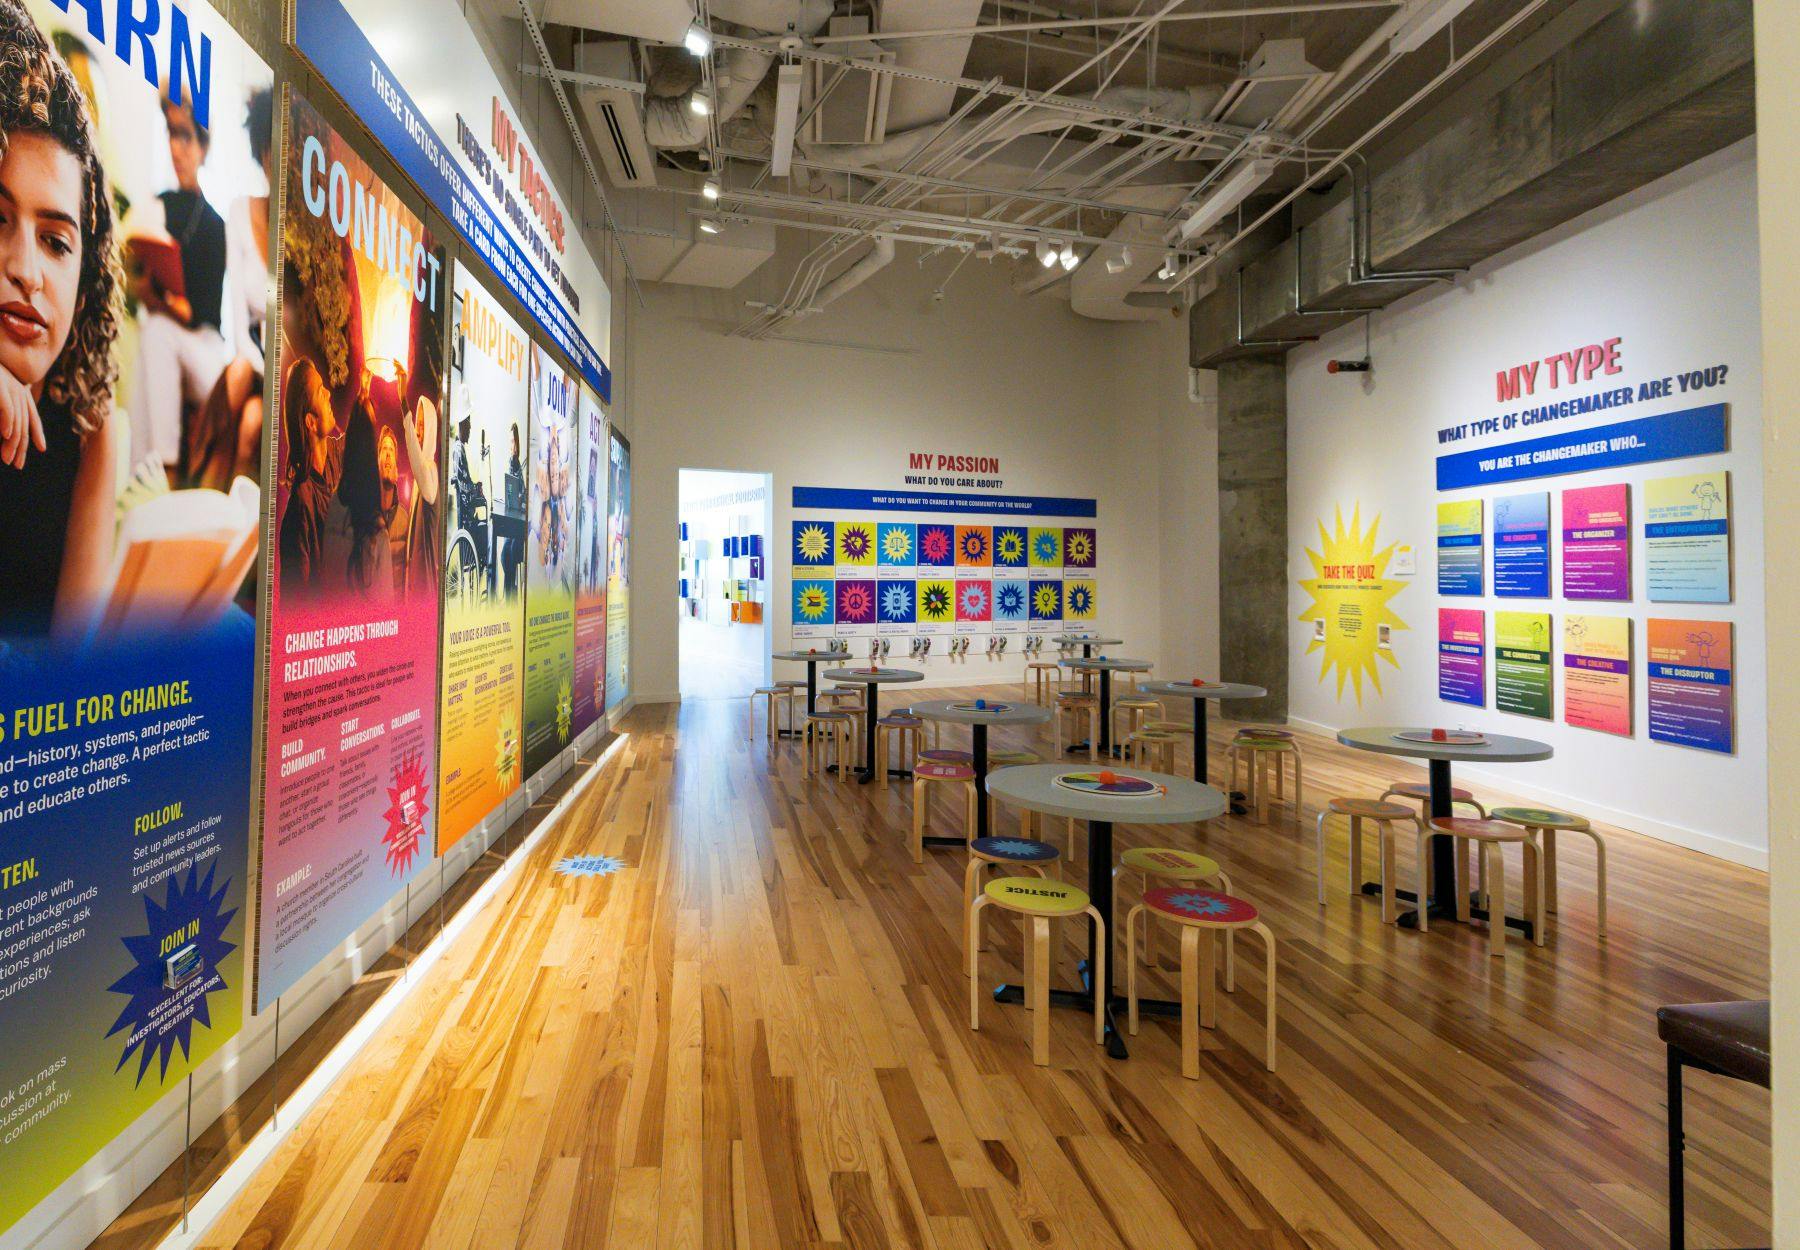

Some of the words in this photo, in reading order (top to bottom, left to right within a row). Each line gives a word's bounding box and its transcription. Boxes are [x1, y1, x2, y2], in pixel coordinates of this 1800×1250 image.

[370, 60, 403, 122] THESE
[404, 105, 439, 168] TACTICS
[440, 154, 461, 195] OFFER
[462, 181, 494, 237] DIFFERENT
[456, 113, 491, 185] THERE'S
[492, 95, 517, 173] MY
[302, 135, 440, 313] CONNECT
[452, 196, 468, 231] TAKE
[468, 216, 474, 239] A
[460, 287, 526, 383] AMPLIFY
[1496, 360, 1539, 403] MY
[1544, 337, 1622, 390] TYPE
[547, 371, 567, 418] JOIN
[1437, 423, 1467, 444] WHAT
[1470, 418, 1500, 440] TYPE
[1503, 412, 1518, 430] OF
[1521, 386, 1634, 427] CHANGEMAKER
[1637, 376, 1672, 402] ARE
[1677, 364, 1728, 393] YOU?
[589, 411, 600, 446] ACT
[909, 453, 934, 471] MY
[937, 454, 999, 474] PASSION
[1479, 457, 1496, 472] YOU
[1497, 455, 1515, 469] ARE
[1515, 453, 1531, 466] THE
[1532, 440, 1608, 464] CHANGEMAKER
[1610, 434, 1646, 451] WHO...
[905, 475, 927, 486] WHAT
[928, 477, 939, 486] DO
[940, 477, 955, 487] YOU
[956, 478, 975, 488] CARE
[976, 479, 1003, 489] ABOUT?
[872, 496, 887, 504] WHAT
[907, 497, 922, 505] WANT
[929, 498, 949, 506] CHANGE
[955, 499, 968, 507] YOUR
[1323, 565, 1340, 580] TAKE
[1342, 565, 1356, 580] THE
[1357, 564, 1375, 582] QUIZ
[285, 629, 324, 654] CHANGE
[327, 626, 365, 648] HAPPENS
[366, 620, 399, 637] THROUGH
[450, 631, 462, 645] YOUR
[284, 650, 357, 682] RELATIONSHIPS.
[1660, 667, 1673, 676] THE
[1674, 668, 1715, 680] DISRUPTOR
[282, 700, 316, 721] strengthen
[317, 697, 326, 708] the
[283, 688, 301, 702] When
[303, 687, 313, 699] you
[314, 680, 336, 693] connect
[14, 702, 69, 740] FUEL
[76, 694, 114, 727] FOR
[120, 680, 193, 717] CHANGE.
[282, 719, 298, 734] build
[299, 712, 320, 730] bridges
[322, 708, 331, 720] and
[333, 703, 347, 718] spark
[341, 718, 359, 735] START
[85, 730, 138, 755] systems,
[141, 720, 160, 739] and
[163, 713, 204, 736] people—
[282, 739, 303, 759] BUILD
[340, 723, 385, 752] CONVERSATIONS.
[13, 779, 29, 795] to
[33, 765, 79, 789] create
[82, 753, 129, 775] change.
[132, 745, 140, 761] A
[143, 736, 181, 761] perfect
[183, 728, 210, 746] tactic
[281, 747, 326, 777] COMMUNITY.
[28, 786, 85, 814] educate
[88, 773, 131, 795] others.
[133, 845, 149, 860] Set
[150, 841, 161, 853] up
[162, 831, 185, 847] alerts
[186, 823, 200, 837] and
[201, 814, 222, 830] follow
[134, 801, 184, 836] FOLLOW.
[132, 876, 149, 894] and
[150, 856, 193, 885] community
[194, 844, 222, 862] leaders.
[133, 853, 164, 877] trusted
[165, 846, 185, 862] news
[186, 832, 215, 851] sources
[1, 857, 39, 890] TEN.
[276, 863, 312, 897] EXAMPLE:
[7, 891, 48, 920] people
[51, 878, 74, 897] with
[28, 886, 98, 927] backgrounds
[1006, 886, 1068, 899] JUSTICE
[0, 918, 70, 960] experiences;
[73, 906, 91, 924] ask
[32, 940, 54, 963] and
[56, 927, 86, 951] listen
[159, 926, 185, 958] JOIN
[188, 918, 200, 939] IN
[0, 963, 52, 1000] curiosity.
[189, 976, 204, 991] FOR:
[126, 1002, 183, 1048] INVESTIGATORS,
[183, 974, 221, 1005] EDUCATORS,
[158, 1004, 195, 1036] CREATIVES
[0, 1089, 15, 1108] ok
[19, 1078, 34, 1095] on
[37, 1056, 67, 1084] mass
[45, 1080, 56, 1096] at
[4, 1089, 72, 1144] community.
